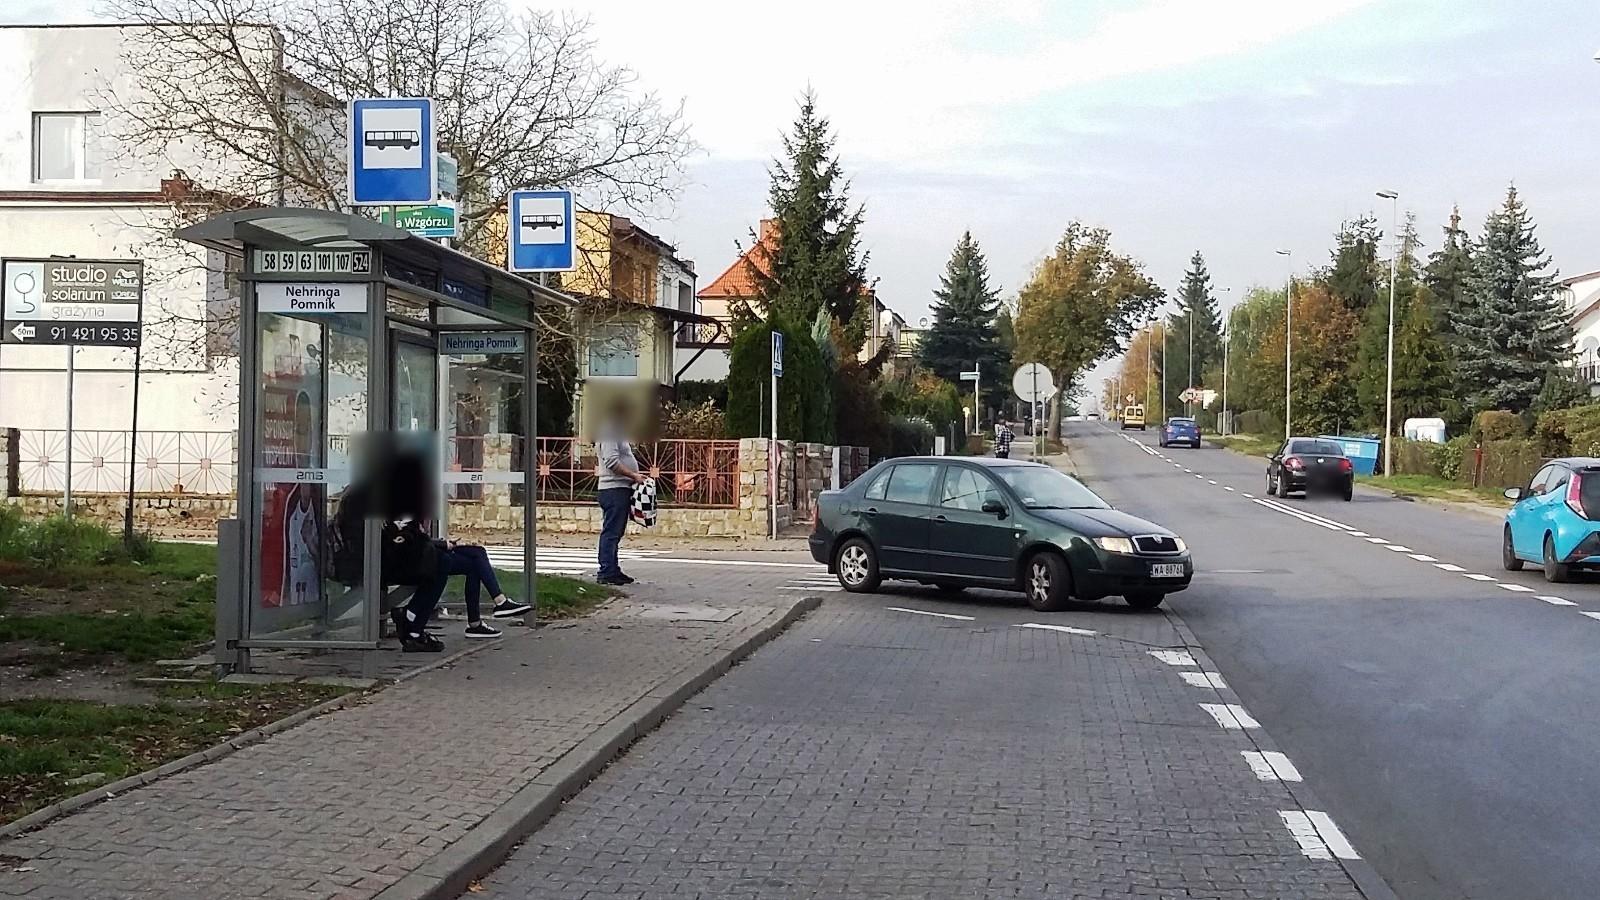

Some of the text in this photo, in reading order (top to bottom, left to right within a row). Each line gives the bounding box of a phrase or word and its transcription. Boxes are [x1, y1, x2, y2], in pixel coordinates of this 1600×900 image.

[404, 215, 448, 229] Wzgórzu
[264, 253, 369, 271] 58 59 63 101 107 524
[51, 265, 107, 282] studio
[51, 287, 106, 301] solarium
[285, 286, 341, 299] Nehringa
[290, 298, 336, 310] Pomnik
[52, 305, 105, 319] grażyna
[50, 327, 138, 341] 91 421 95 35
[446, 337, 518, 351] Nehringa Pomnik
